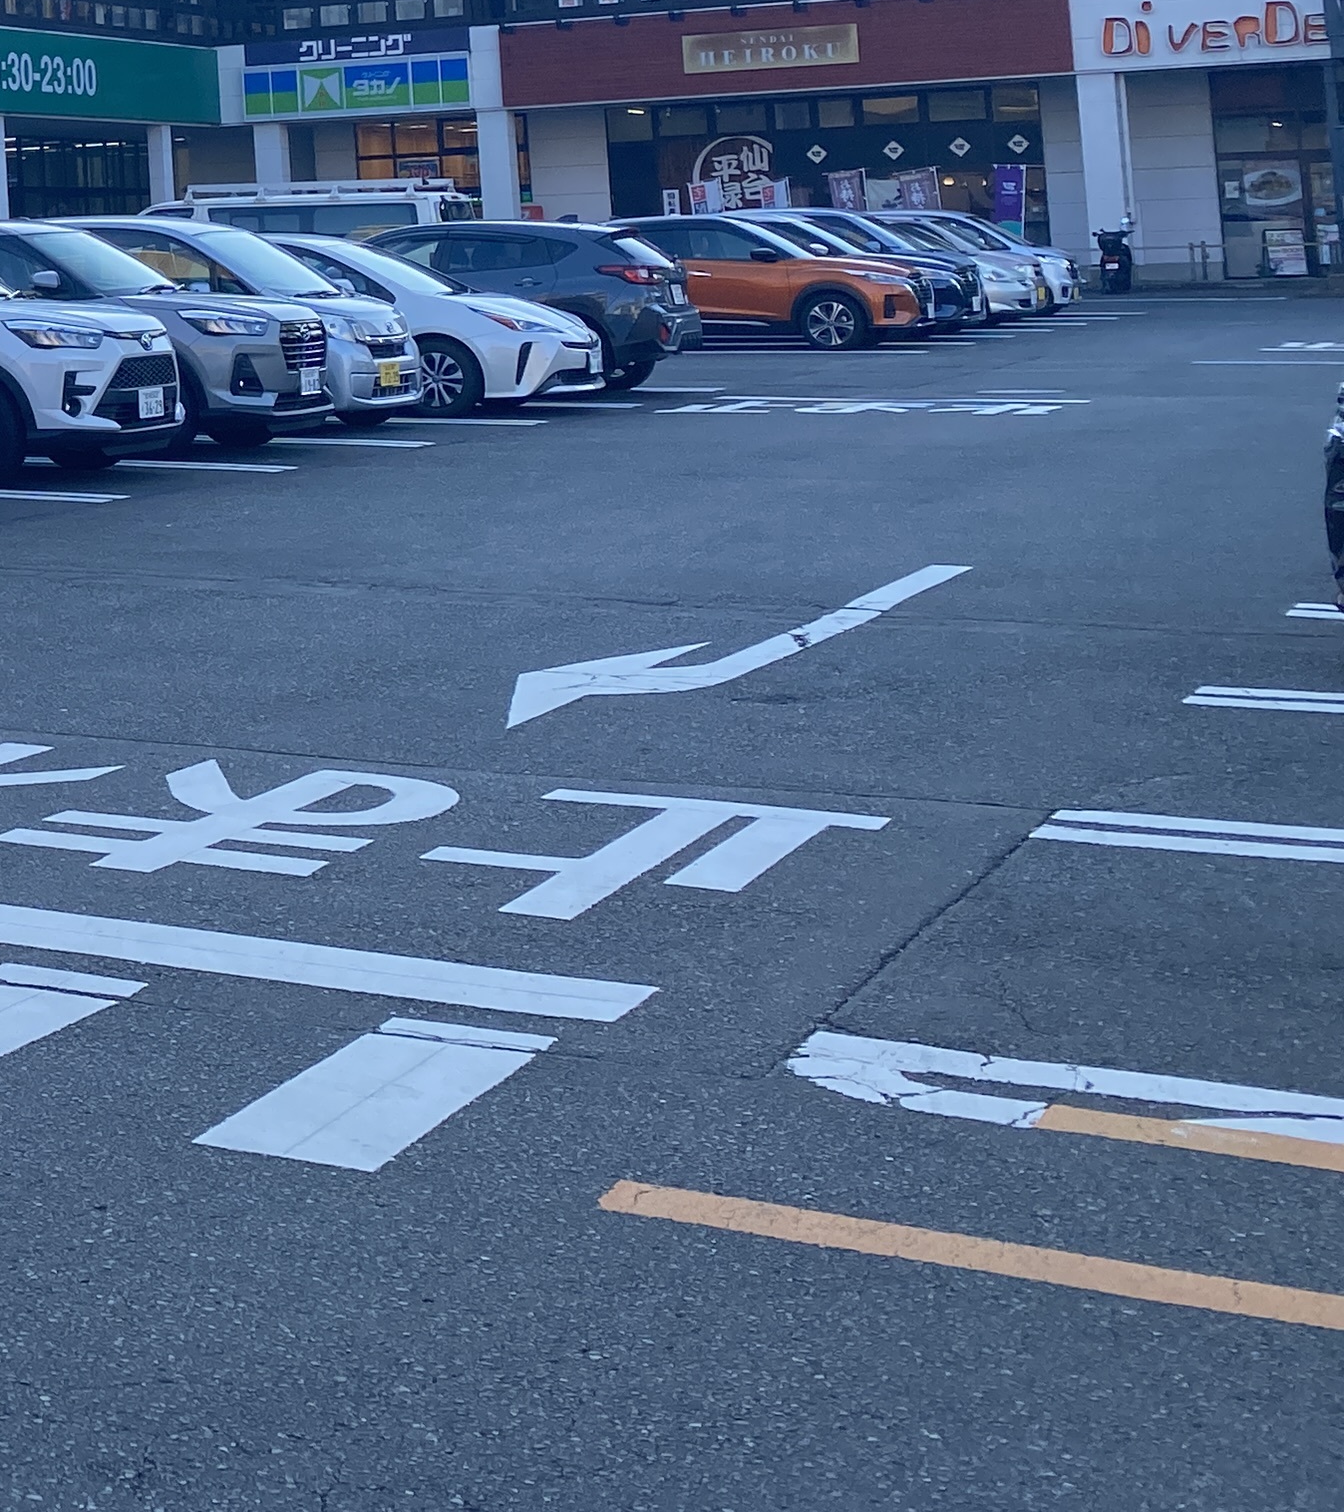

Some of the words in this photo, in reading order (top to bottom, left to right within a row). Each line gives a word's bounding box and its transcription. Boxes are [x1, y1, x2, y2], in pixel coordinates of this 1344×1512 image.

[299, 33, 412, 62] クリーニング
[740, 34, 794, 45] SENDAI
[698, 42, 841, 67] HEIROKU
